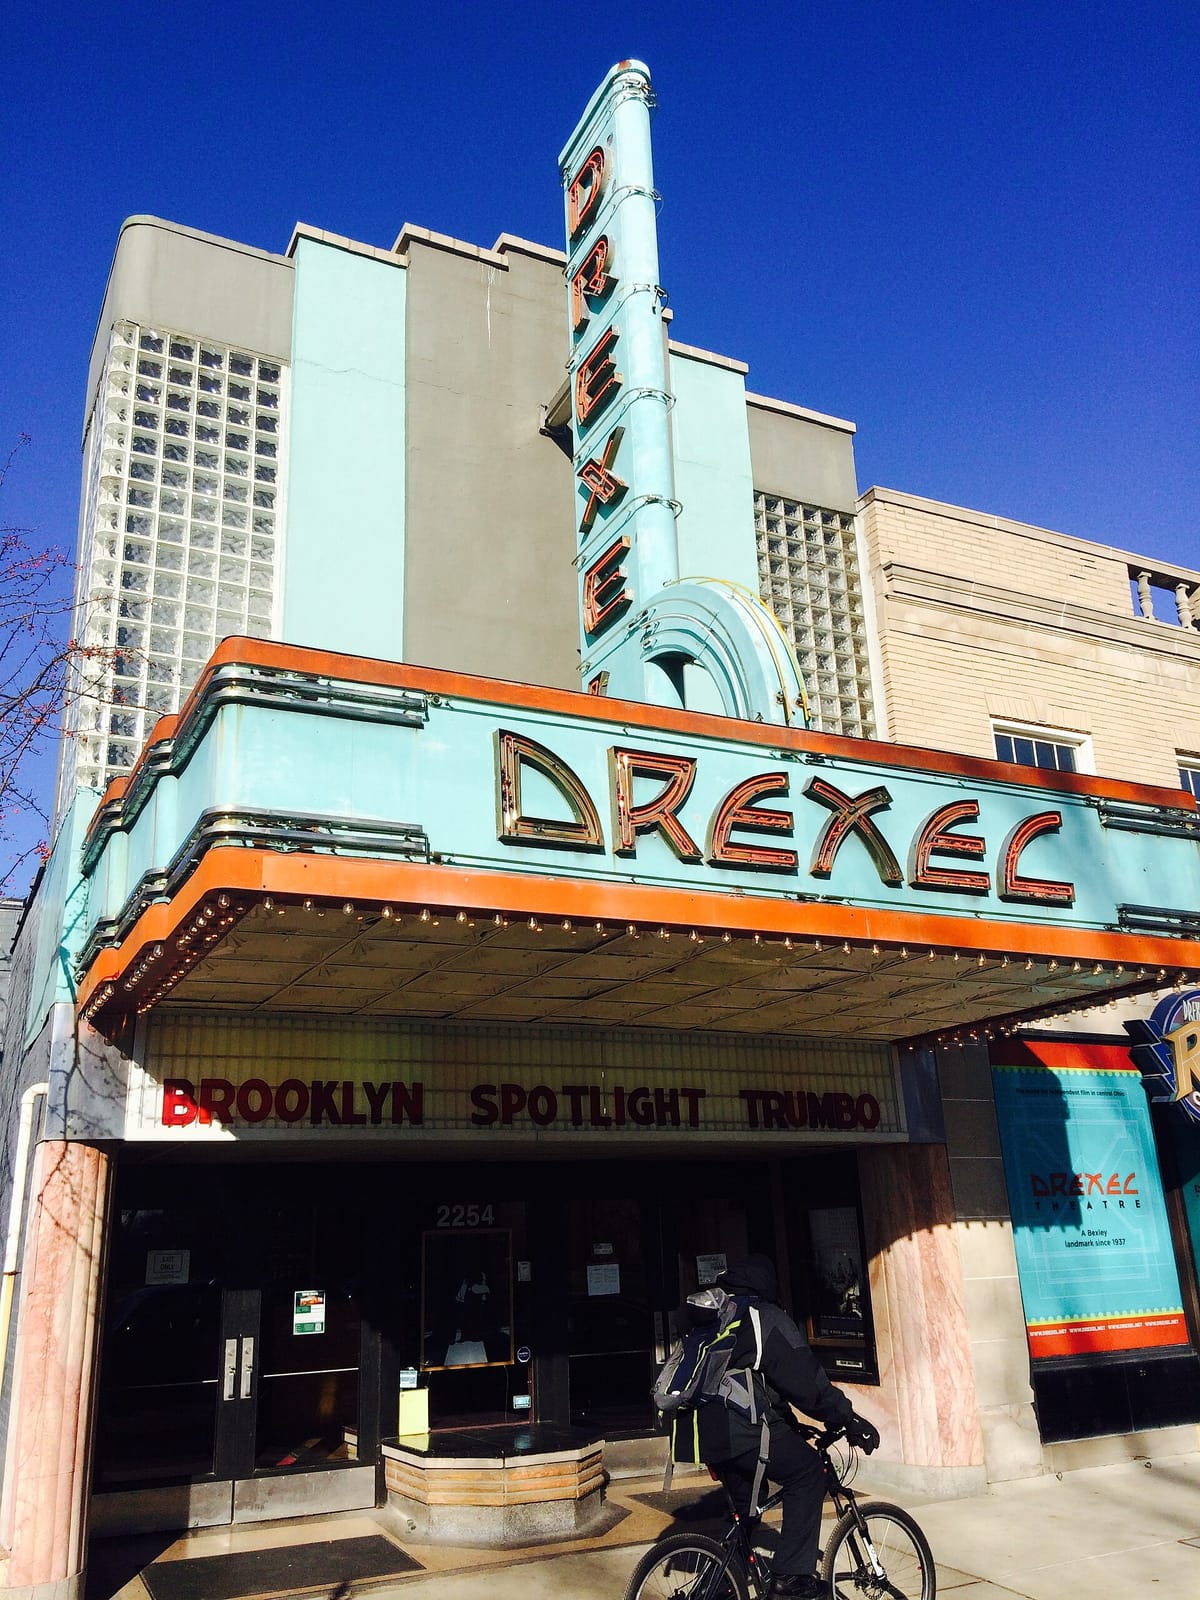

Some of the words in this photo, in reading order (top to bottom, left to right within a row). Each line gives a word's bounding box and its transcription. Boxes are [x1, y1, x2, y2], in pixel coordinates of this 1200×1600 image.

[161, 1077, 423, 1128] BROOKLYN
[471, 1083, 706, 1128] SPOTLIGHT
[739, 1088, 881, 1130] TRUMBO
[436, 1204, 495, 1227] 2254
[1087, 1229, 1108, 1238] Bexley
[1065, 1240, 1094, 1248] landmark
[1095, 1239, 1111, 1247] since
[1112, 1238, 1126, 1246] 1937
